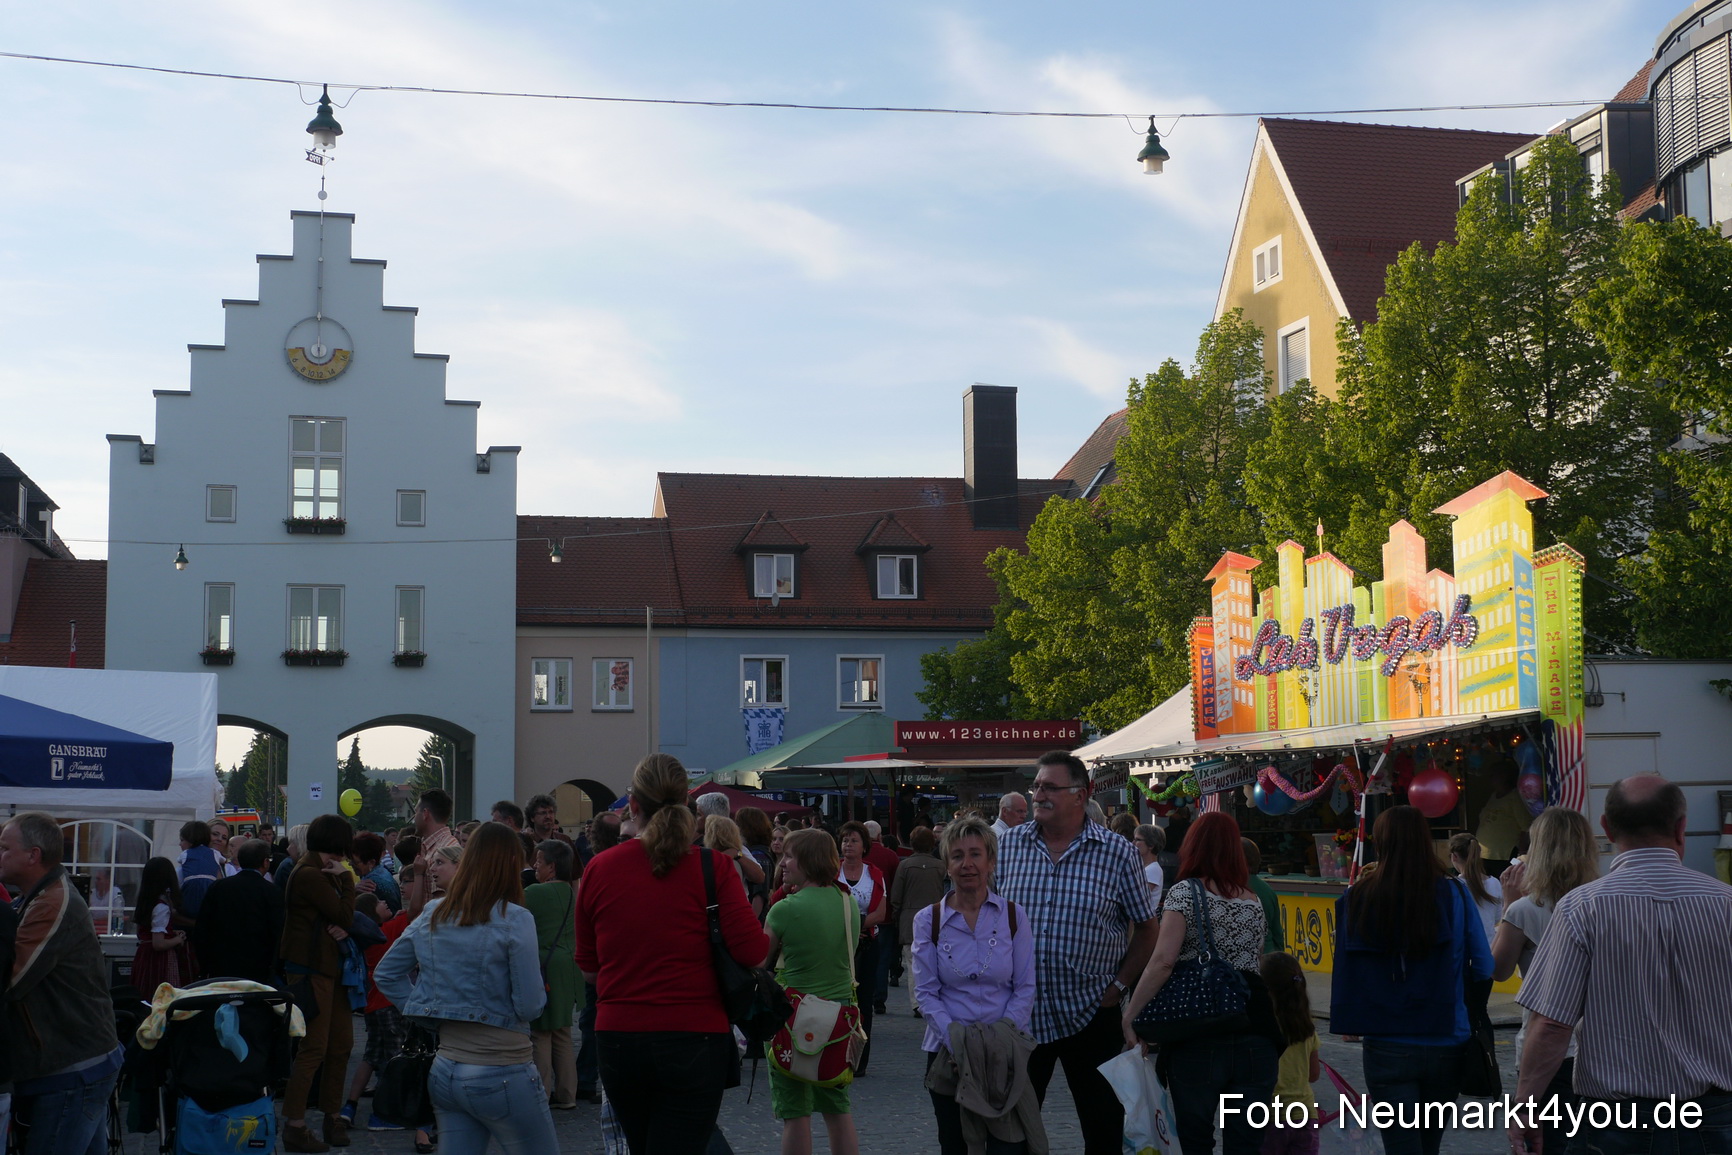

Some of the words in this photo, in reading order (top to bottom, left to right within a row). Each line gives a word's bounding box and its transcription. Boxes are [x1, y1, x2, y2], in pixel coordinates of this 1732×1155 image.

[327, 368, 336, 376] 14
[1213, 593, 1228, 652] MONTE
[1544, 575, 1559, 614] THE
[1235, 617, 1320, 682] Las
[1320, 592, 1480, 678] Vegas
[1516, 572, 1535, 677] IMPERIAL
[1201, 648, 1216, 725] OLEANDER
[1217, 664, 1232, 721] CARLO
[1545, 631, 1562, 711] MIRAGE
[48, 743, 108, 758] GANSBRÄU
[902, 727, 1076, 740] www.123eichner.de
[1095, 772, 1128, 794] AUSWAHL
[1201, 776, 1216, 788] FREIE
[1215, 766, 1254, 790] AUSWAHL
[1281, 903, 1323, 966] LAS
